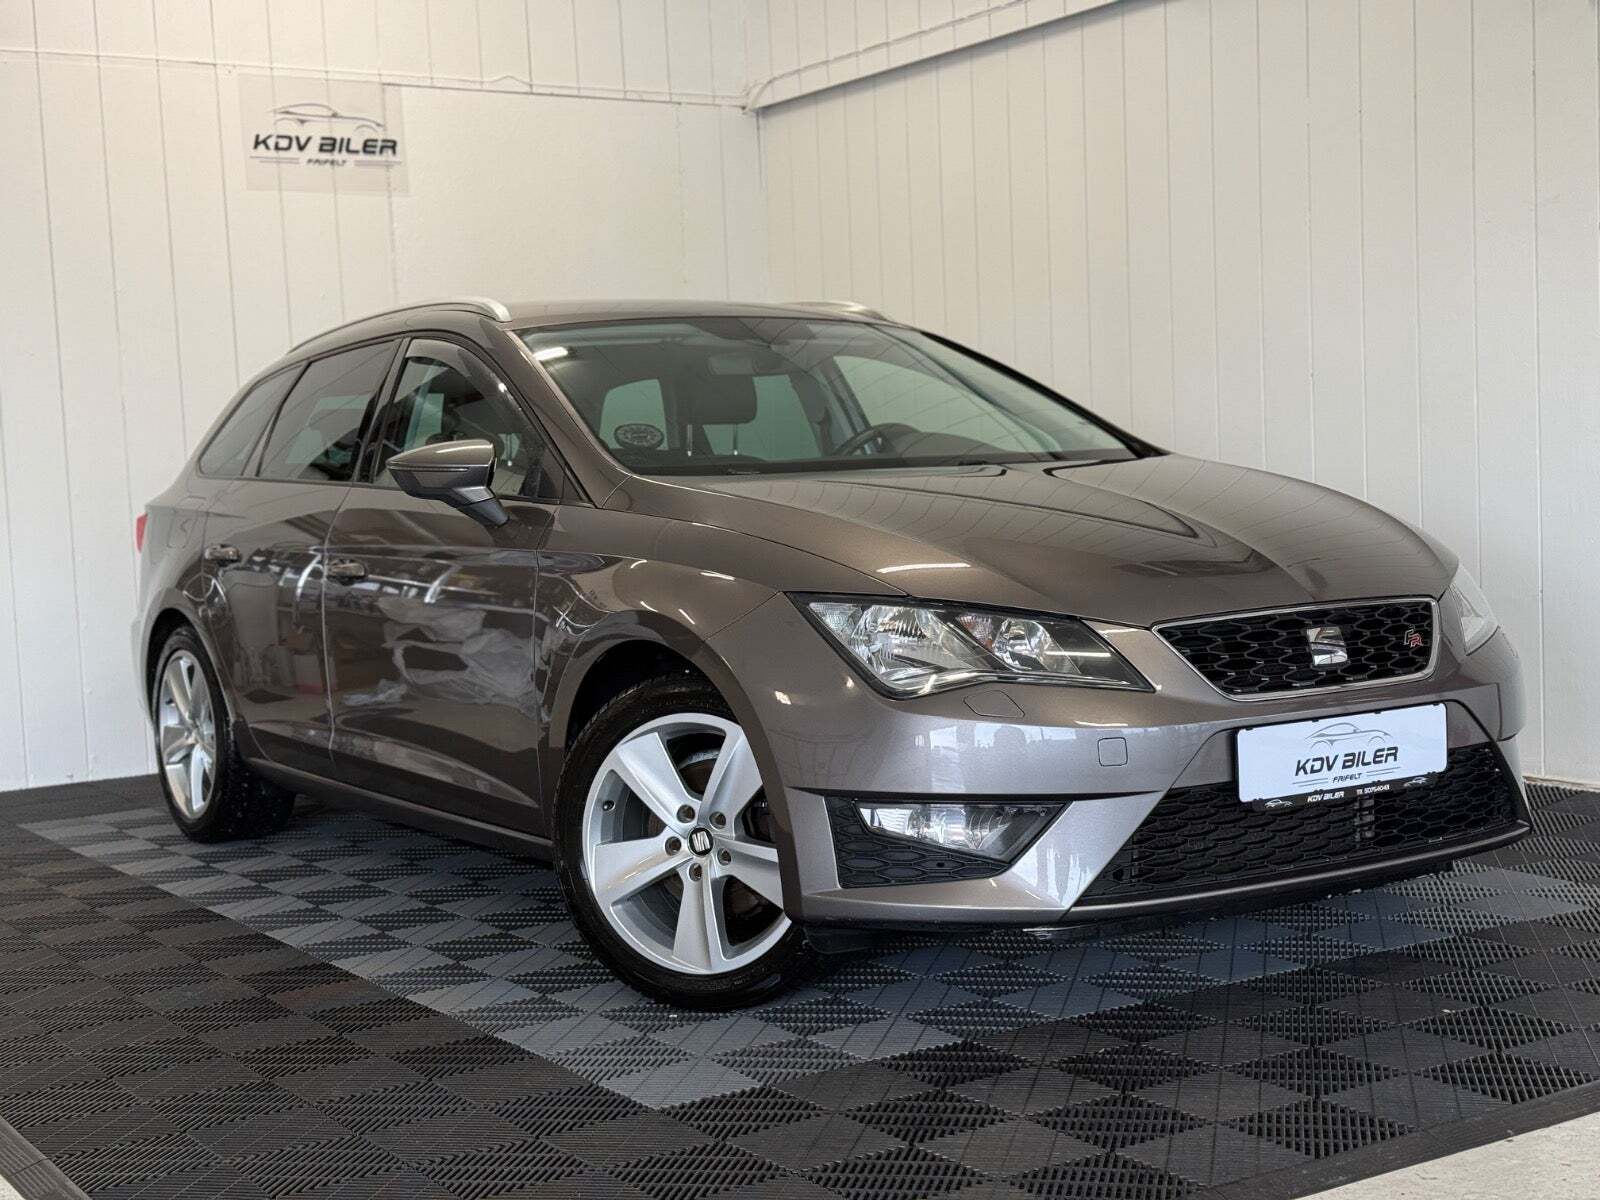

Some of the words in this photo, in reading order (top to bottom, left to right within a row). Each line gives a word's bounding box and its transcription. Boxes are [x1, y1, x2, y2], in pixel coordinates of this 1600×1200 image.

[253, 134, 312, 152] KDV
[318, 136, 398, 156] BILER
[1294, 754, 1339, 777] KDV
[1341, 746, 1398, 770] BILER
[1332, 772, 1362, 784] FRIFELT
[1307, 793, 1324, 803] KDV
[1323, 790, 1345, 801] BILER
